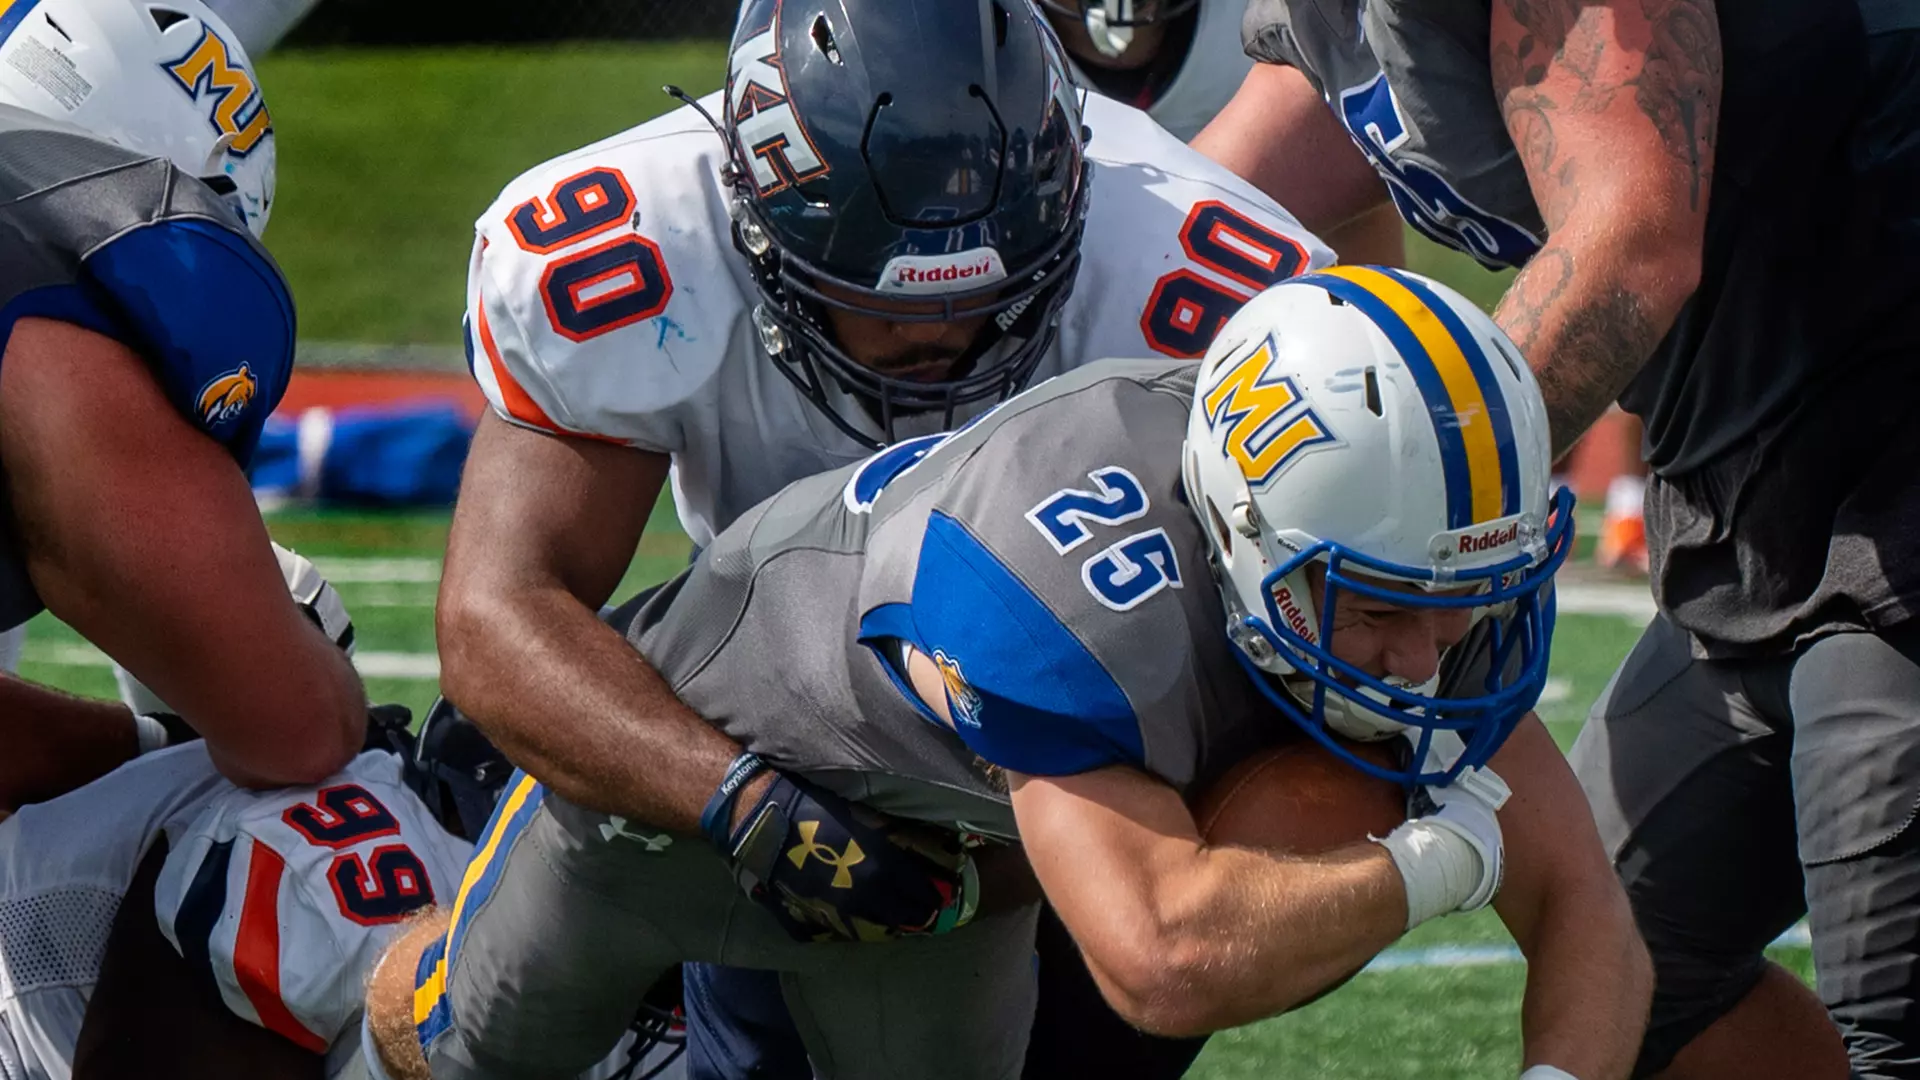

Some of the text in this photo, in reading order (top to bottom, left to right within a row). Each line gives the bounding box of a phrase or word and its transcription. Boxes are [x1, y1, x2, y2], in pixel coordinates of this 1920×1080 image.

[160, 20, 274, 158] MU
[505, 166, 674, 343] 90
[898, 256, 990, 282] Riddell
[1203, 331, 1338, 487] MU
[1024, 465, 1184, 612] 25
[1459, 522, 1518, 553] Riddell
[282, 784, 437, 926] 99
